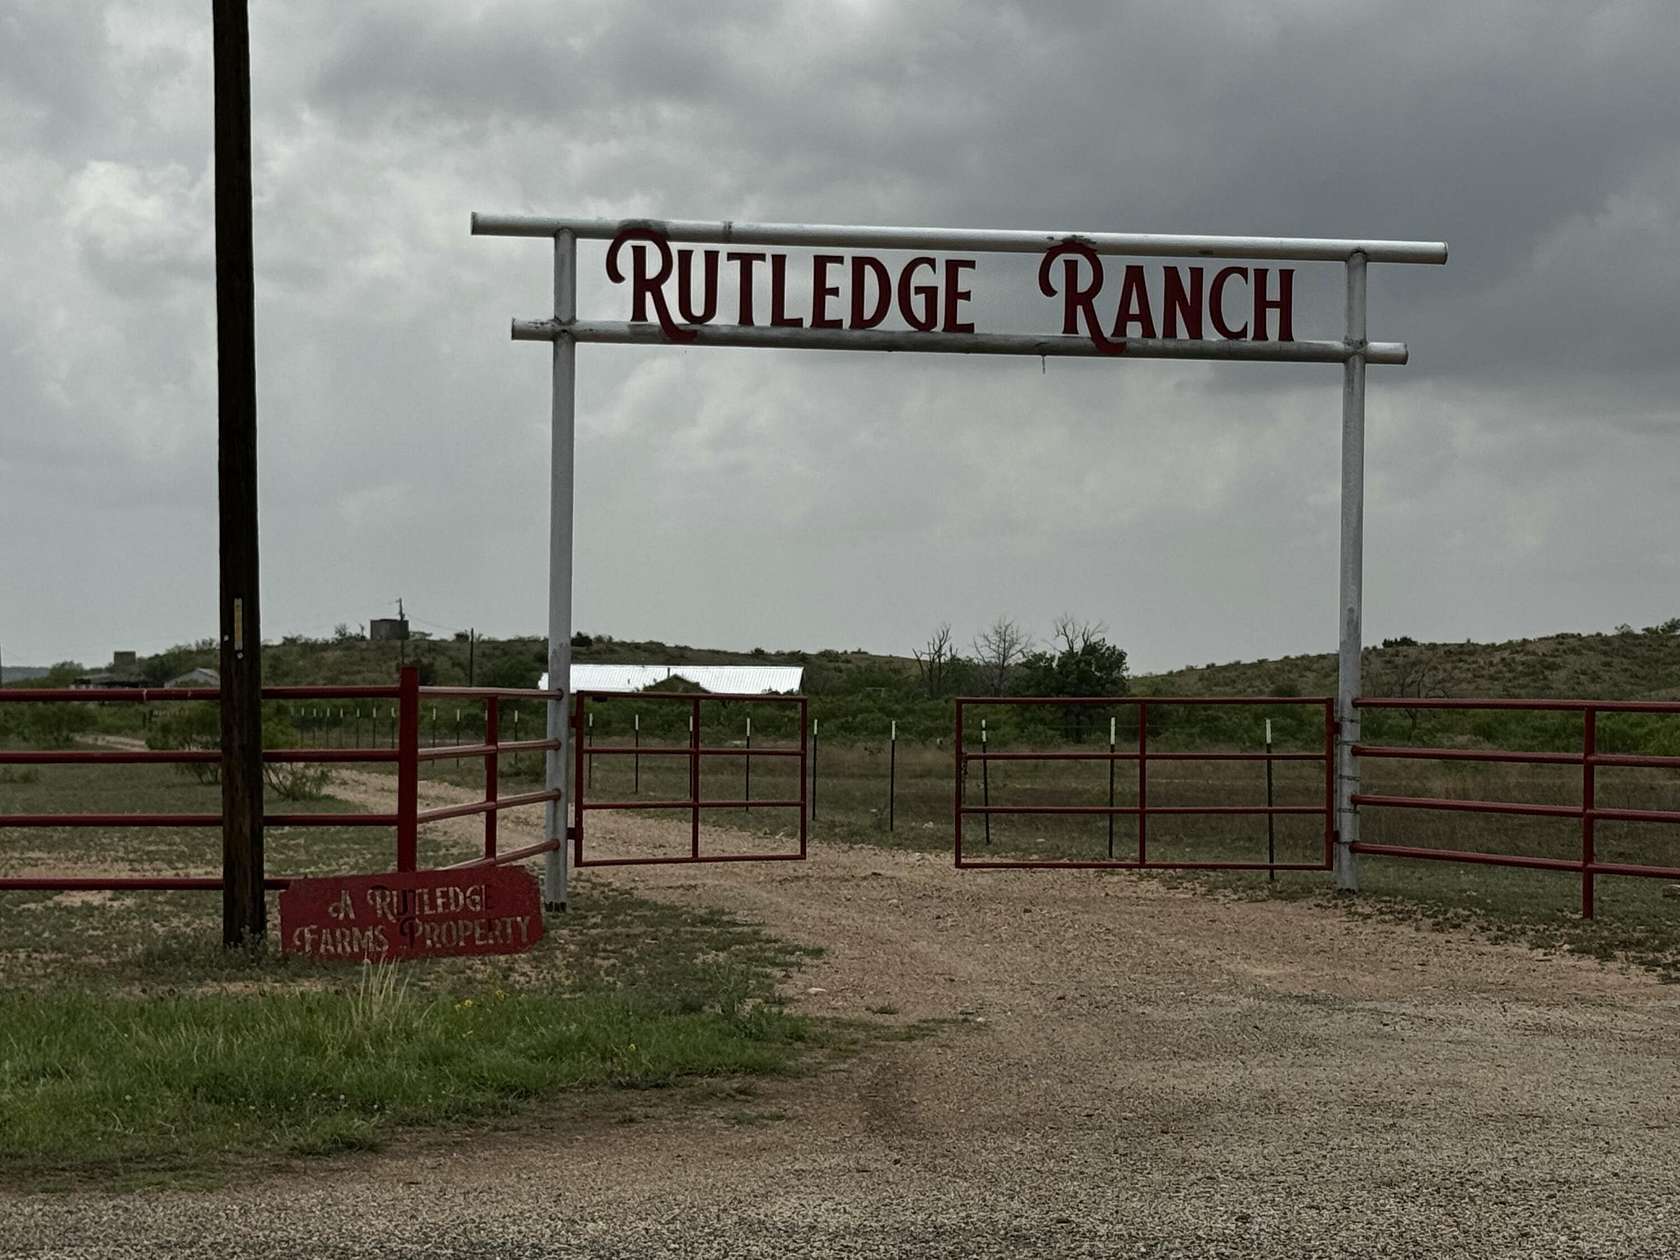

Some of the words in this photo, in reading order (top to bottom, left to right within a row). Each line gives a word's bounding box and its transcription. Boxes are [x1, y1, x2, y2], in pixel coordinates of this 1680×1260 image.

[606, 229, 977, 341] RUTLEDGE
[1039, 241, 1295, 352] RANCH
[329, 889, 356, 921] A
[293, 925, 390, 955] FARMS
[400, 916, 531, 948] PROPERTY
